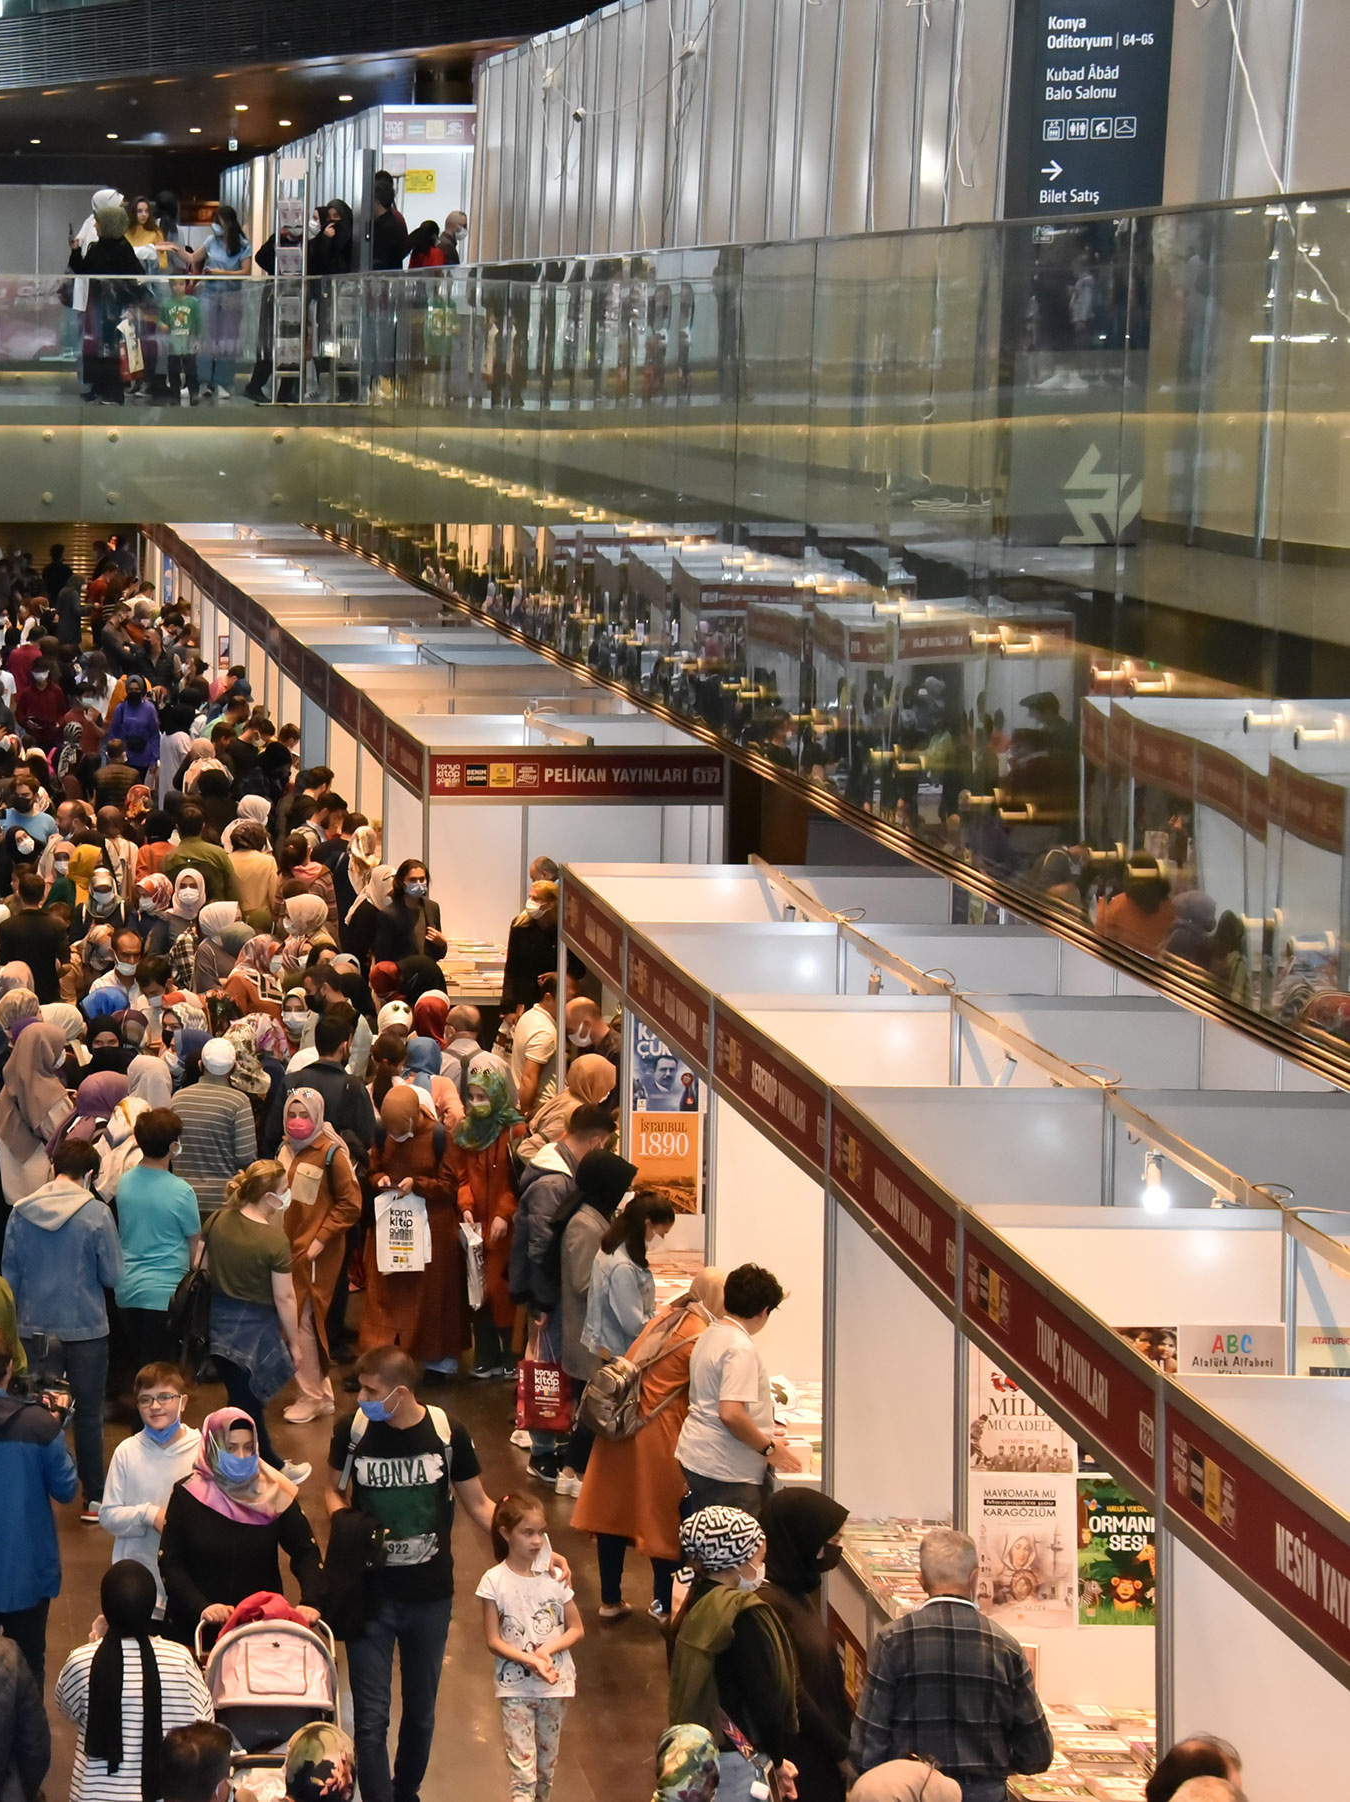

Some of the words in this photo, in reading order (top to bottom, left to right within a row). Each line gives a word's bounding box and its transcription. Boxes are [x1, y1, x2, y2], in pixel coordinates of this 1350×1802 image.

[1048, 16, 1087, 32] Konya
[1047, 34, 1112, 50] Oditoryum
[1046, 67, 1085, 82] Kubad
[1088, 64, 1119, 80] Âbâd
[1045, 86, 1072, 101] Balo
[1075, 86, 1117, 100] Salonu
[1040, 190, 1067, 204] Bilet
[1070, 189, 1100, 205] Satış
[544, 765, 606, 782] PELİKAN
[611, 767, 687, 783] YAYINLARI
[638, 1132, 689, 1157] 1890
[900, 1191, 931, 1255] YAYINLARI
[1211, 1334, 1252, 1354] ABC
[1036, 1316, 1059, 1384] TUNÇ
[1061, 1339, 1108, 1419] YAYINLARI
[1192, 1356, 1228, 1367] Atatürk
[534, 1368, 559, 1378] konya
[534, 1376, 559, 1385] kitap
[988, 1394, 1046, 1416] MİLL
[987, 1417, 1055, 1431] MÜCADELE
[366, 1459, 428, 1486] KONYA
[983, 1489, 1039, 1498] MAVROMATA
[1042, 1490, 1056, 1498] MU
[983, 1507, 1056, 1517] KARAGÖZLÜM
[1089, 1515, 1155, 1533] ORMANI
[388, 1543, 409, 1554] 922
[1109, 1534, 1148, 1551] SESİ
[1275, 1522, 1317, 1601] NESİN
